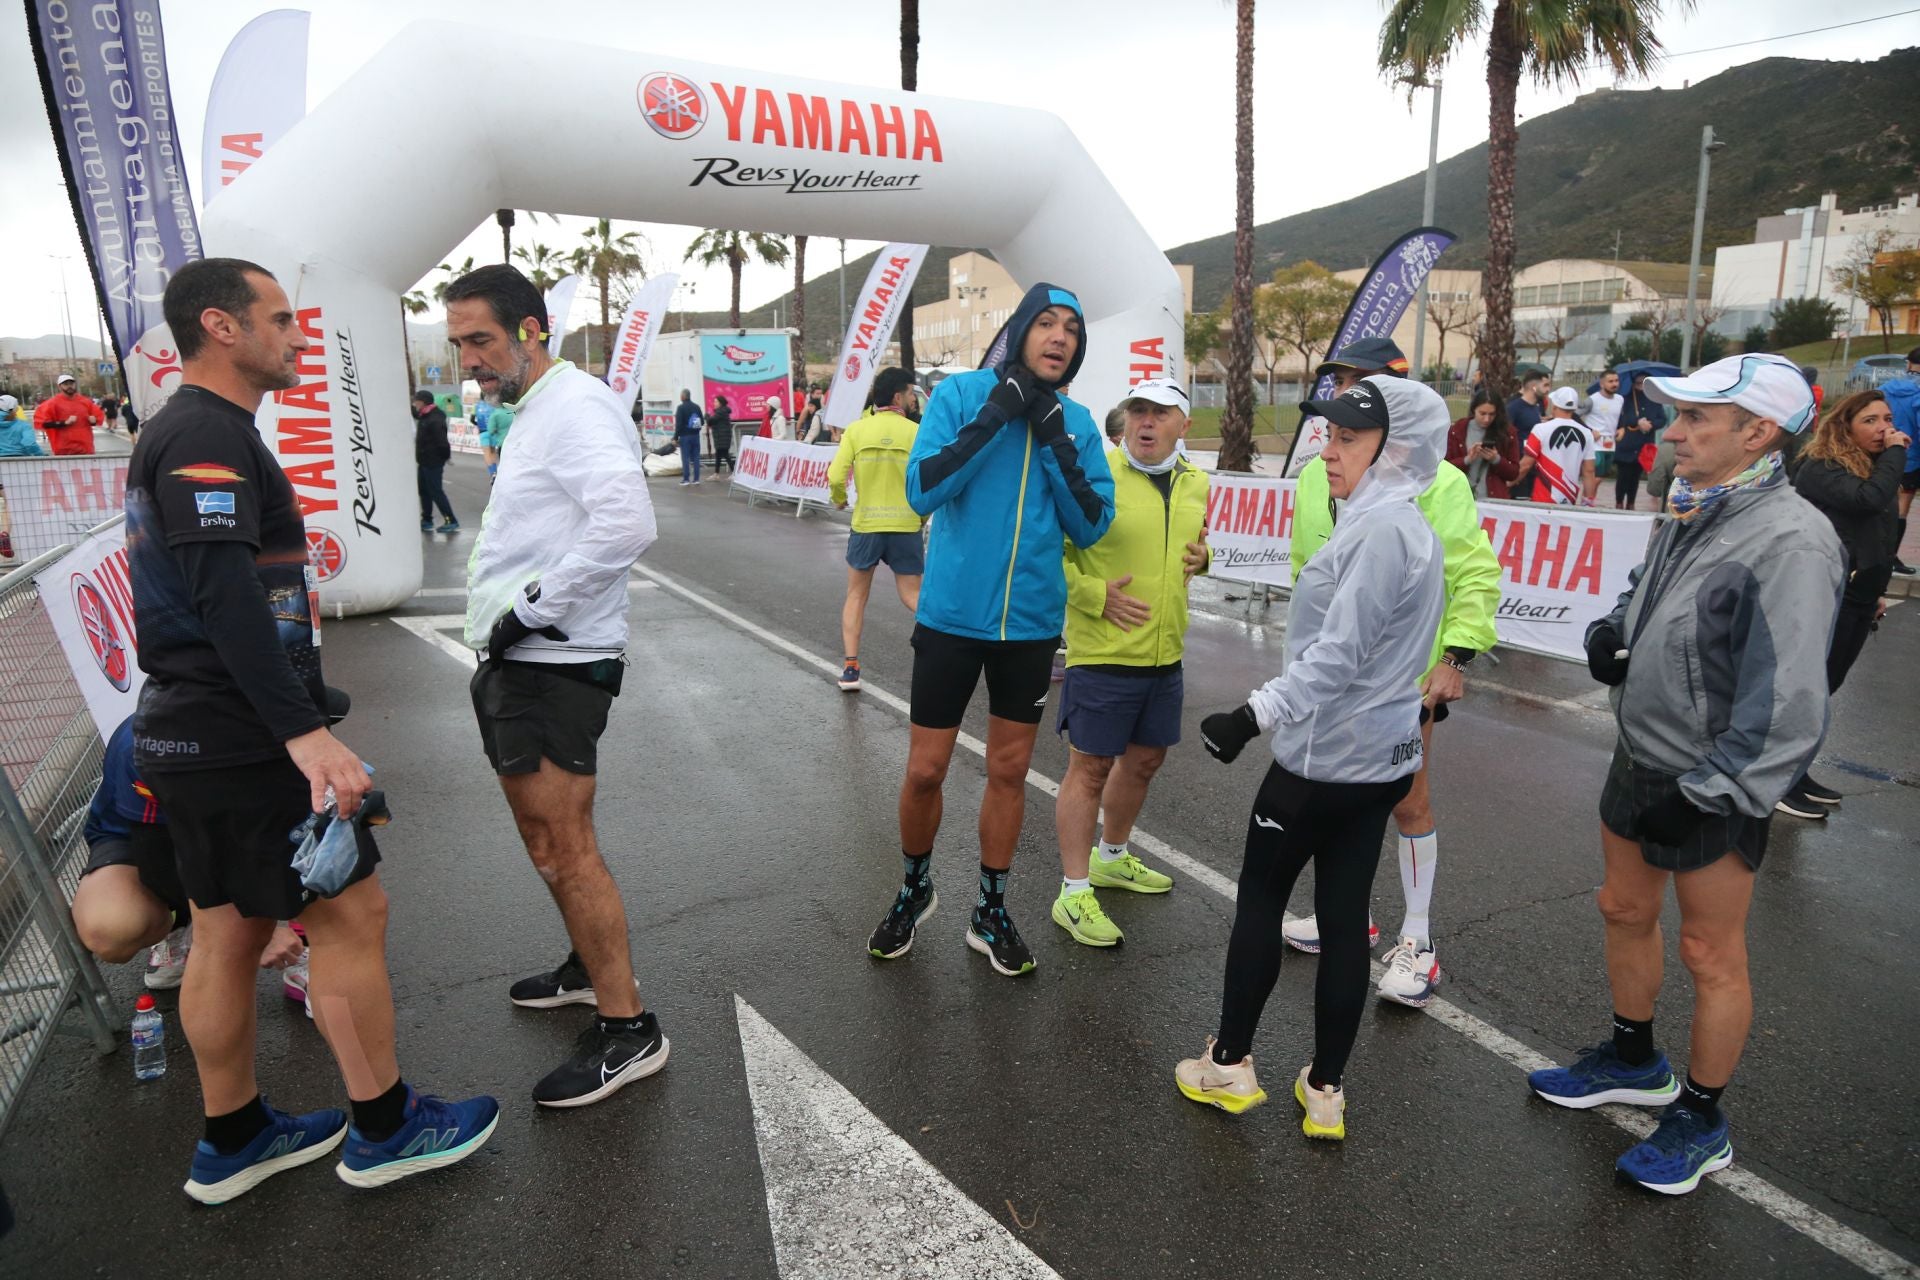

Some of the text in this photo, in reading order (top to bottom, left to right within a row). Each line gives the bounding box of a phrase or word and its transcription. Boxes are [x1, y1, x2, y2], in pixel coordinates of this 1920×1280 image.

[134, 10, 169, 121] DEPORTES
[157, 130, 175, 157] DE
[710, 82, 943, 163] YAMAHA
[688, 157, 922, 193] Revs Your Heart
[852, 256, 911, 351] YAMAHA
[616, 309, 650, 374] YAMAHA
[336, 328, 382, 537] Revs Your Heart
[200, 516, 236, 528] Ership
[1225, 548, 1262, 567] Your
[1498, 597, 1571, 619] Heart
